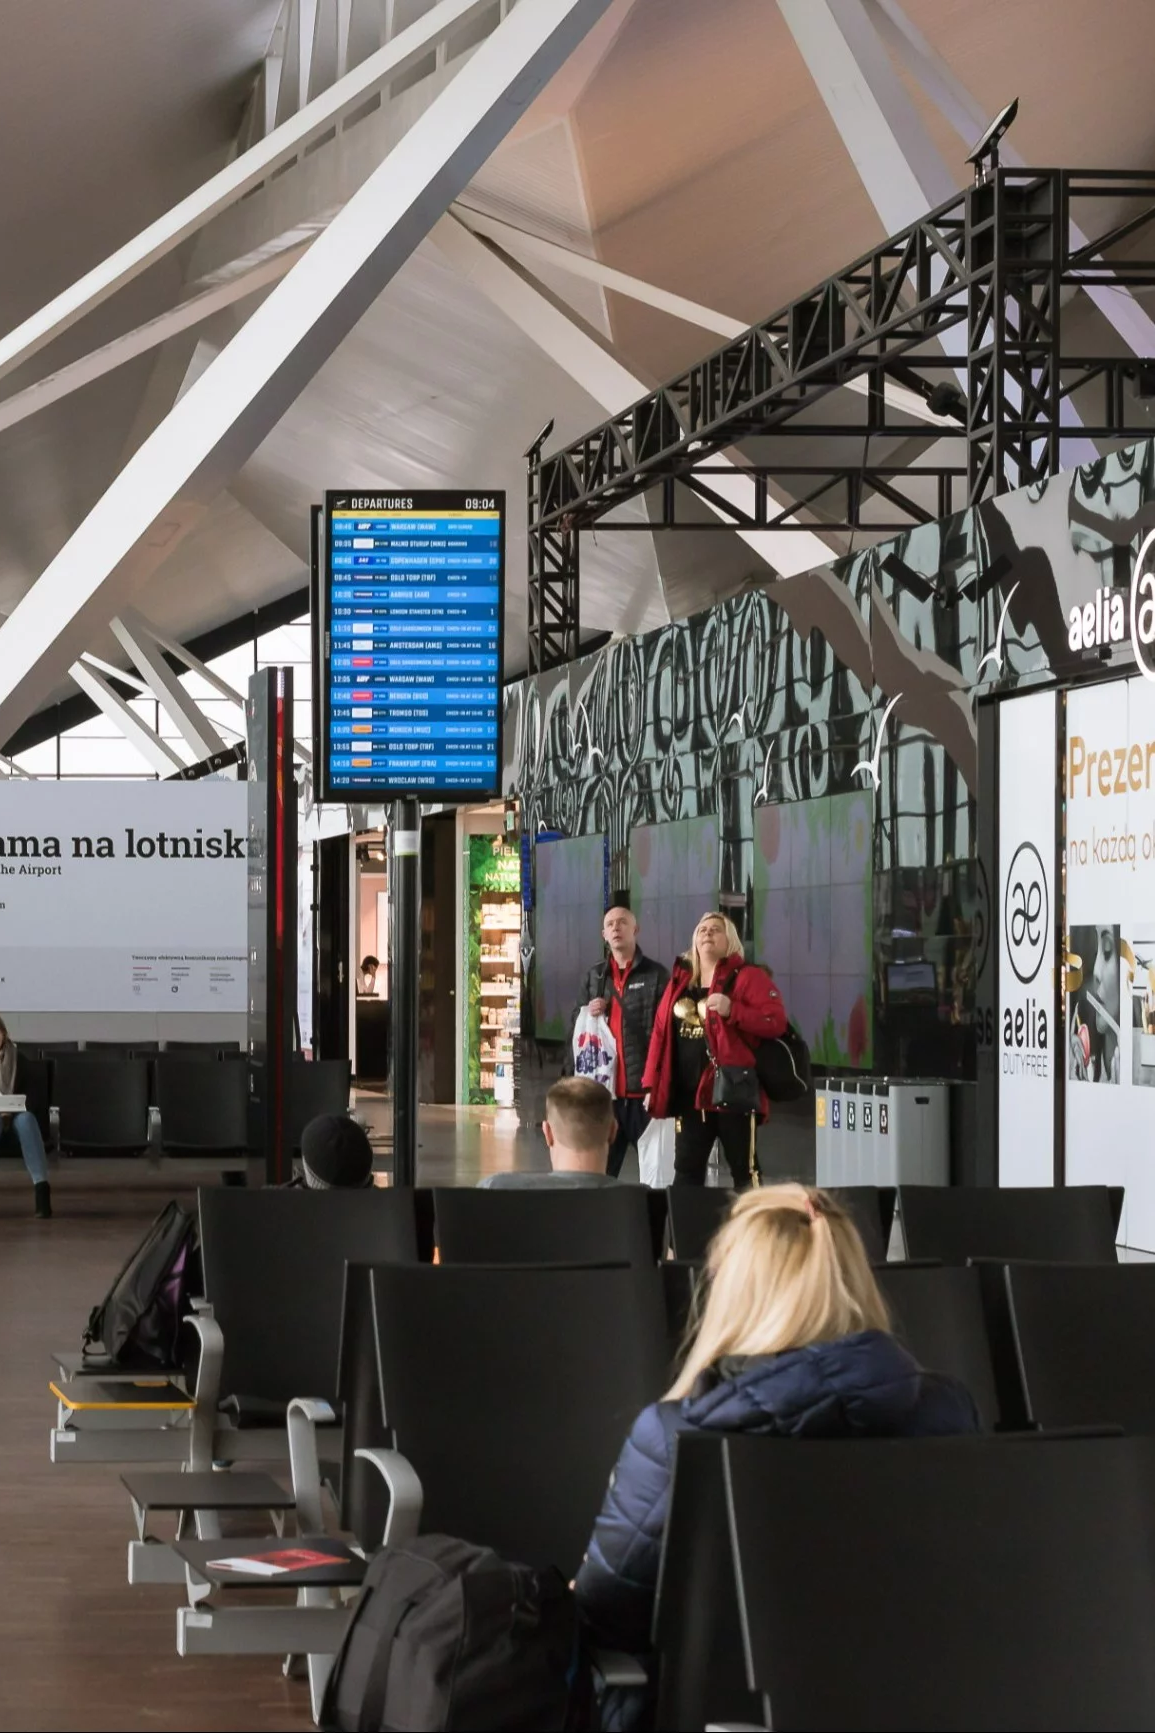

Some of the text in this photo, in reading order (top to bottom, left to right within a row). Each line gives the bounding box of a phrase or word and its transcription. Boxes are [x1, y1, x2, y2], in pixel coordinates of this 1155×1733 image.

[351, 498, 495, 509] DEPARTURES 09:04
[1068, 586, 1125, 652] aelia
[390, 641, 424, 649] AMSTERDAM
[389, 675, 414, 683] WARSAW
[71, 836, 116, 858] na
[125, 828, 249, 858] lotnisk
[1069, 820, 1155, 872] na każdą o
[19, 863, 62, 877] Airport
[1003, 998, 1048, 1049] aelia
